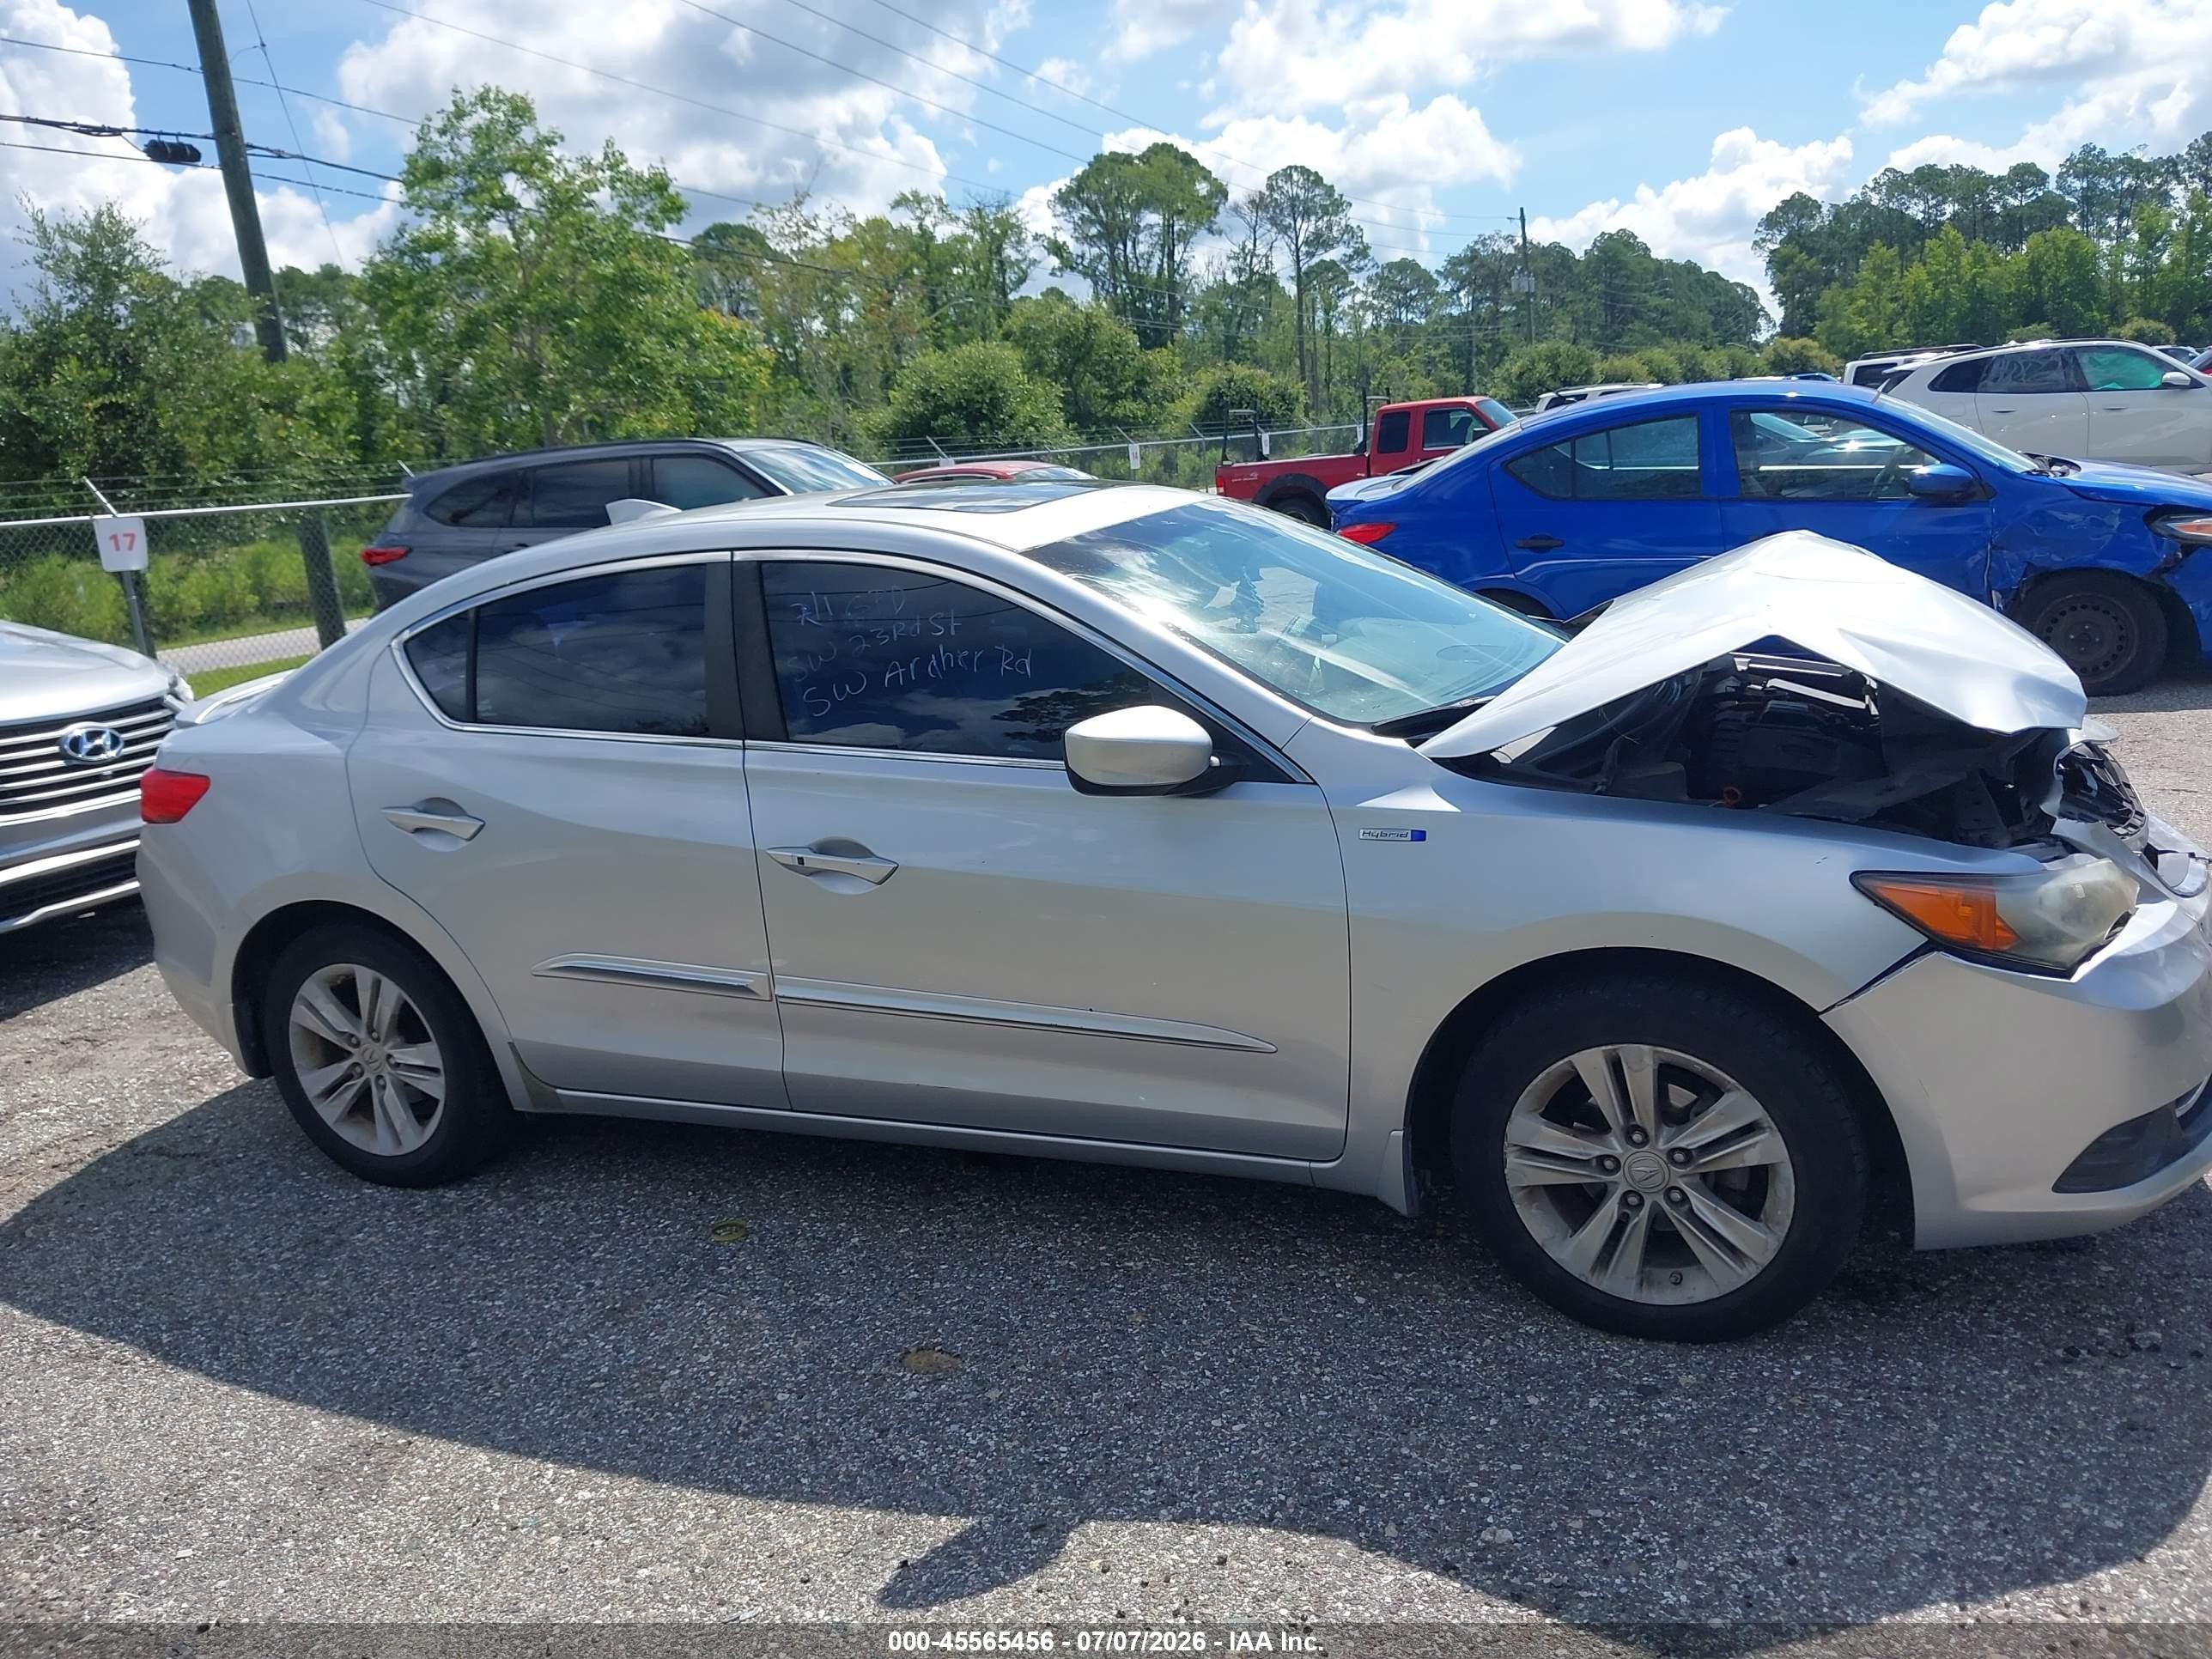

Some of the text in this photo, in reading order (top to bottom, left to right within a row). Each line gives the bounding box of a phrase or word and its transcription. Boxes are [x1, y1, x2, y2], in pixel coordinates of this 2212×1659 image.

[109, 532, 136, 551] 17
[803, 671, 867, 717] SW
[994, 645, 1031, 678] Rd
